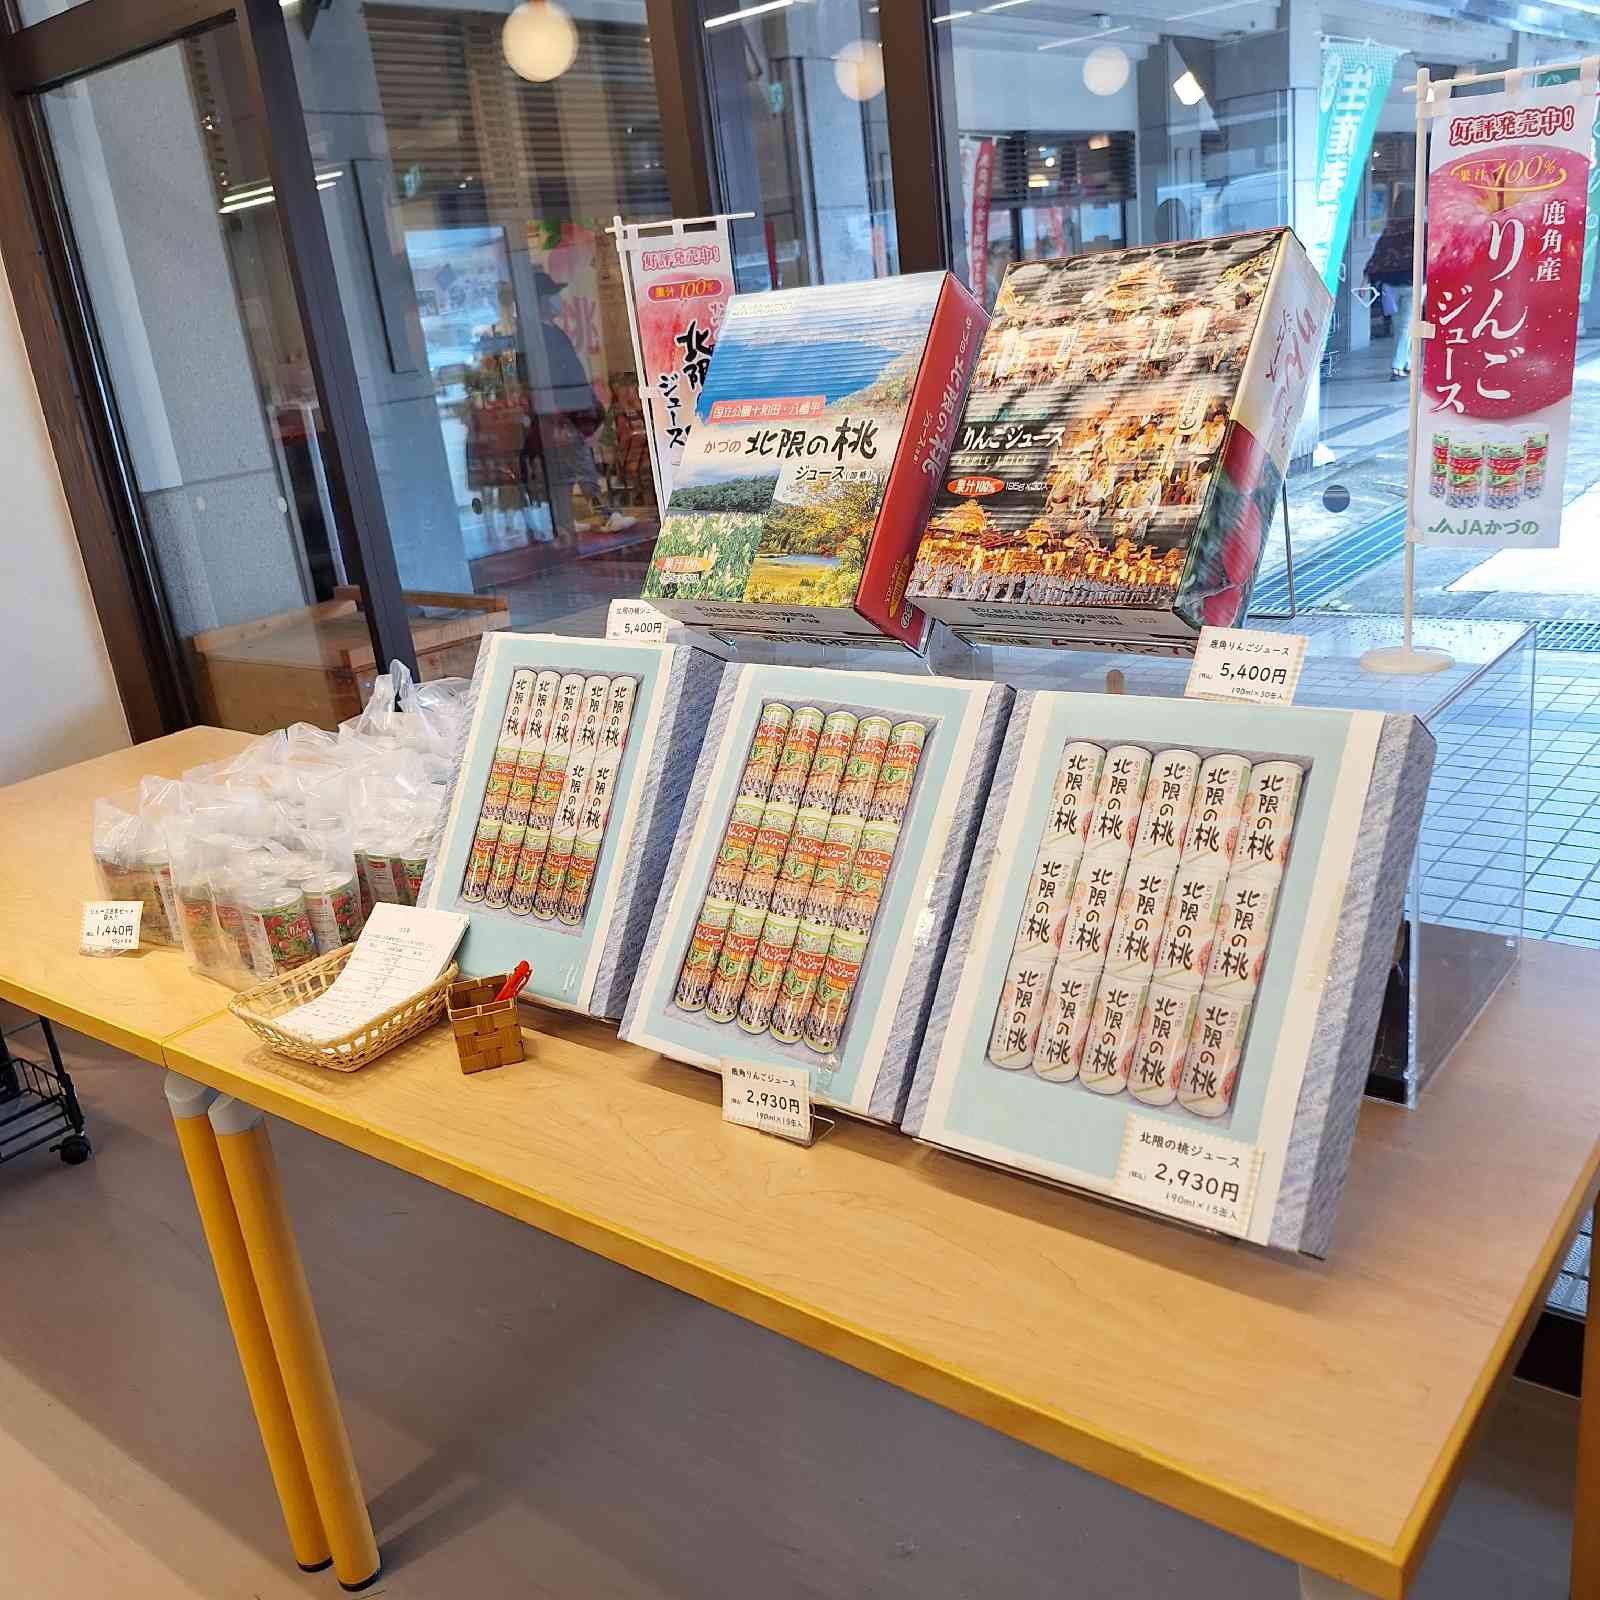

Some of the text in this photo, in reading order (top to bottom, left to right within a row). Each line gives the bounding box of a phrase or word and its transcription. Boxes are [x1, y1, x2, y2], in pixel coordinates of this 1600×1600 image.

[1536, 201, 1566, 282] 鹿角産
[1431, 284, 1473, 414] ジュース
[1472, 218, 1528, 400] りんご
[658, 375, 685, 449] ジュース
[704, 417, 879, 461] かづの 北限の桃
[963, 424, 1066, 453] りんごジュース
[624, 622, 662, 635] 5,400円
[507, 679, 528, 737] 北限の桃
[529, 680, 550, 738] 北限の桃
[555, 684, 577, 744] 北限の桃
[1219, 663, 1287, 685] 5,400円
[582, 686, 603, 745] 北限の桃
[605, 685, 627, 746] 北限の桃
[561, 765, 584, 827] 北限の桃
[585, 768, 609, 829] 北限の桃
[1055, 754, 1088, 835] 北限の桃
[1099, 758, 1133, 840] 北限の桃
[1150, 762, 1185, 847] 北限の桃
[1194, 768, 1229, 852] 北限の桃
[1247, 774, 1284, 861] 北限の桃
[96, 924, 133, 936] 1,440円
[1027, 860, 1061, 943] 北限の桃
[1077, 868, 1112, 953] 北限の桃
[1125, 875, 1161, 963] 北限の桃
[1167, 881, 1205, 970] 北限の桃
[1221, 889, 1260, 980] 北限の桃
[1005, 970, 1038, 1053] 北限の桃
[1047, 980, 1081, 1064] 北限の桃
[1093, 989, 1129, 1076] 北限の桃
[1140, 996, 1175, 1087] 北限の桃
[1191, 1006, 1229, 1098] 北限の桃
[746, 1089, 800, 1114] 2,930円
[1140, 1131, 1240, 1168] 北限の桃ジュース
[1154, 1163, 1239, 1203] 2,930円
